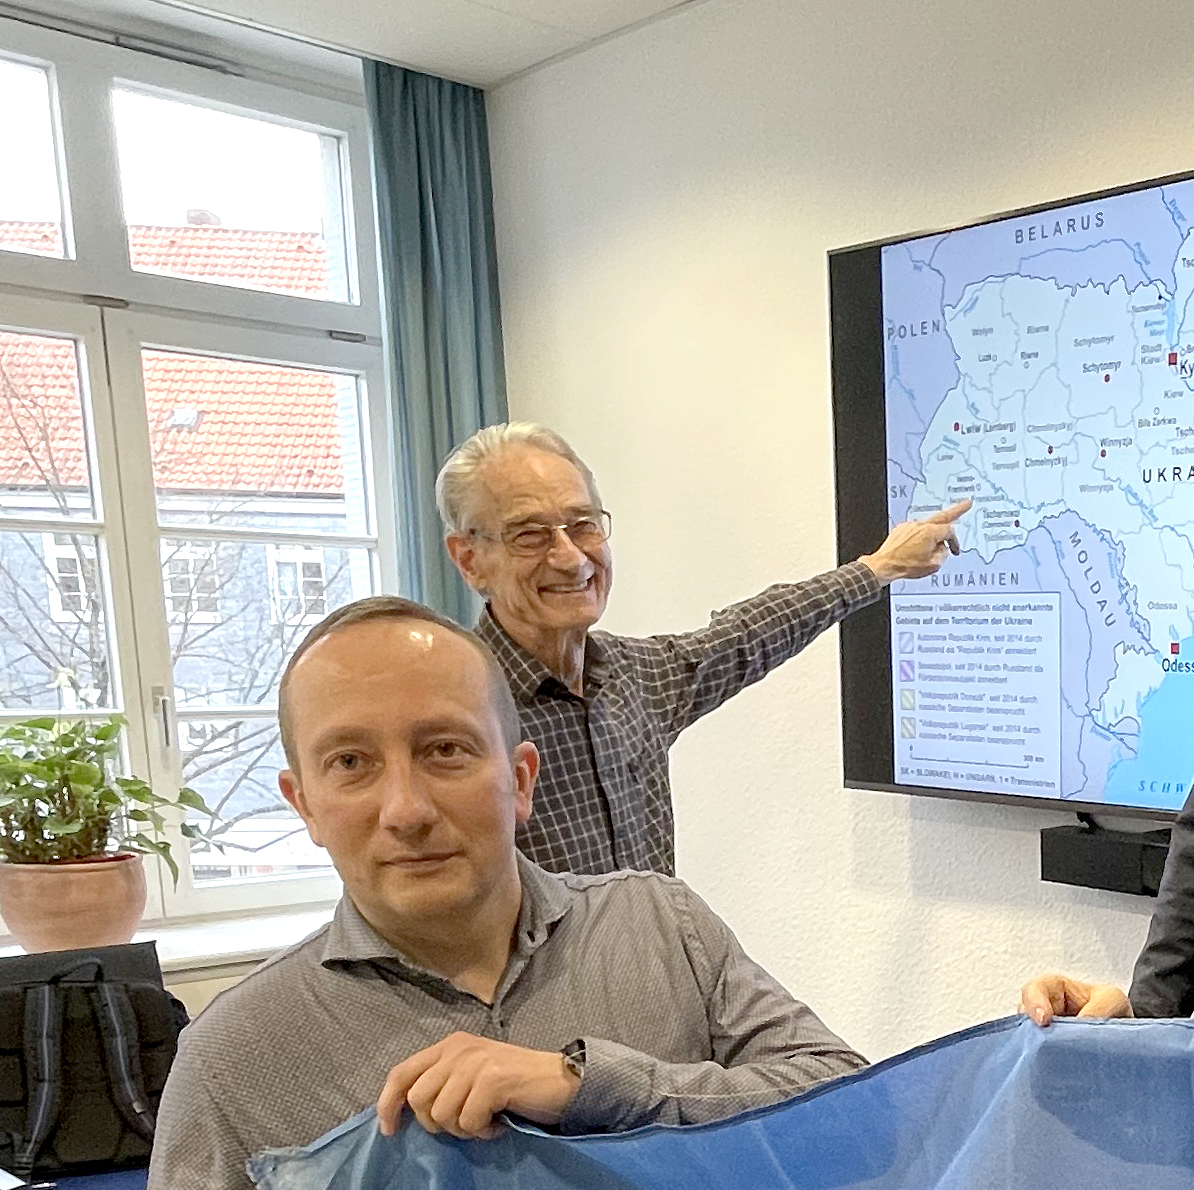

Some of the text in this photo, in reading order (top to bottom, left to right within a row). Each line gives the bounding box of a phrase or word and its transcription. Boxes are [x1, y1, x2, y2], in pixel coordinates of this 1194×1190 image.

[1014, 211, 1105, 244] BELARUS
[887, 319, 941, 341] POLEN
[890, 485, 908, 498] SK
[931, 570, 1020, 587] RUMÄNIEN
[1069, 531, 1117, 627] MOLDAU
[1138, 780, 1186, 794] SCHW
